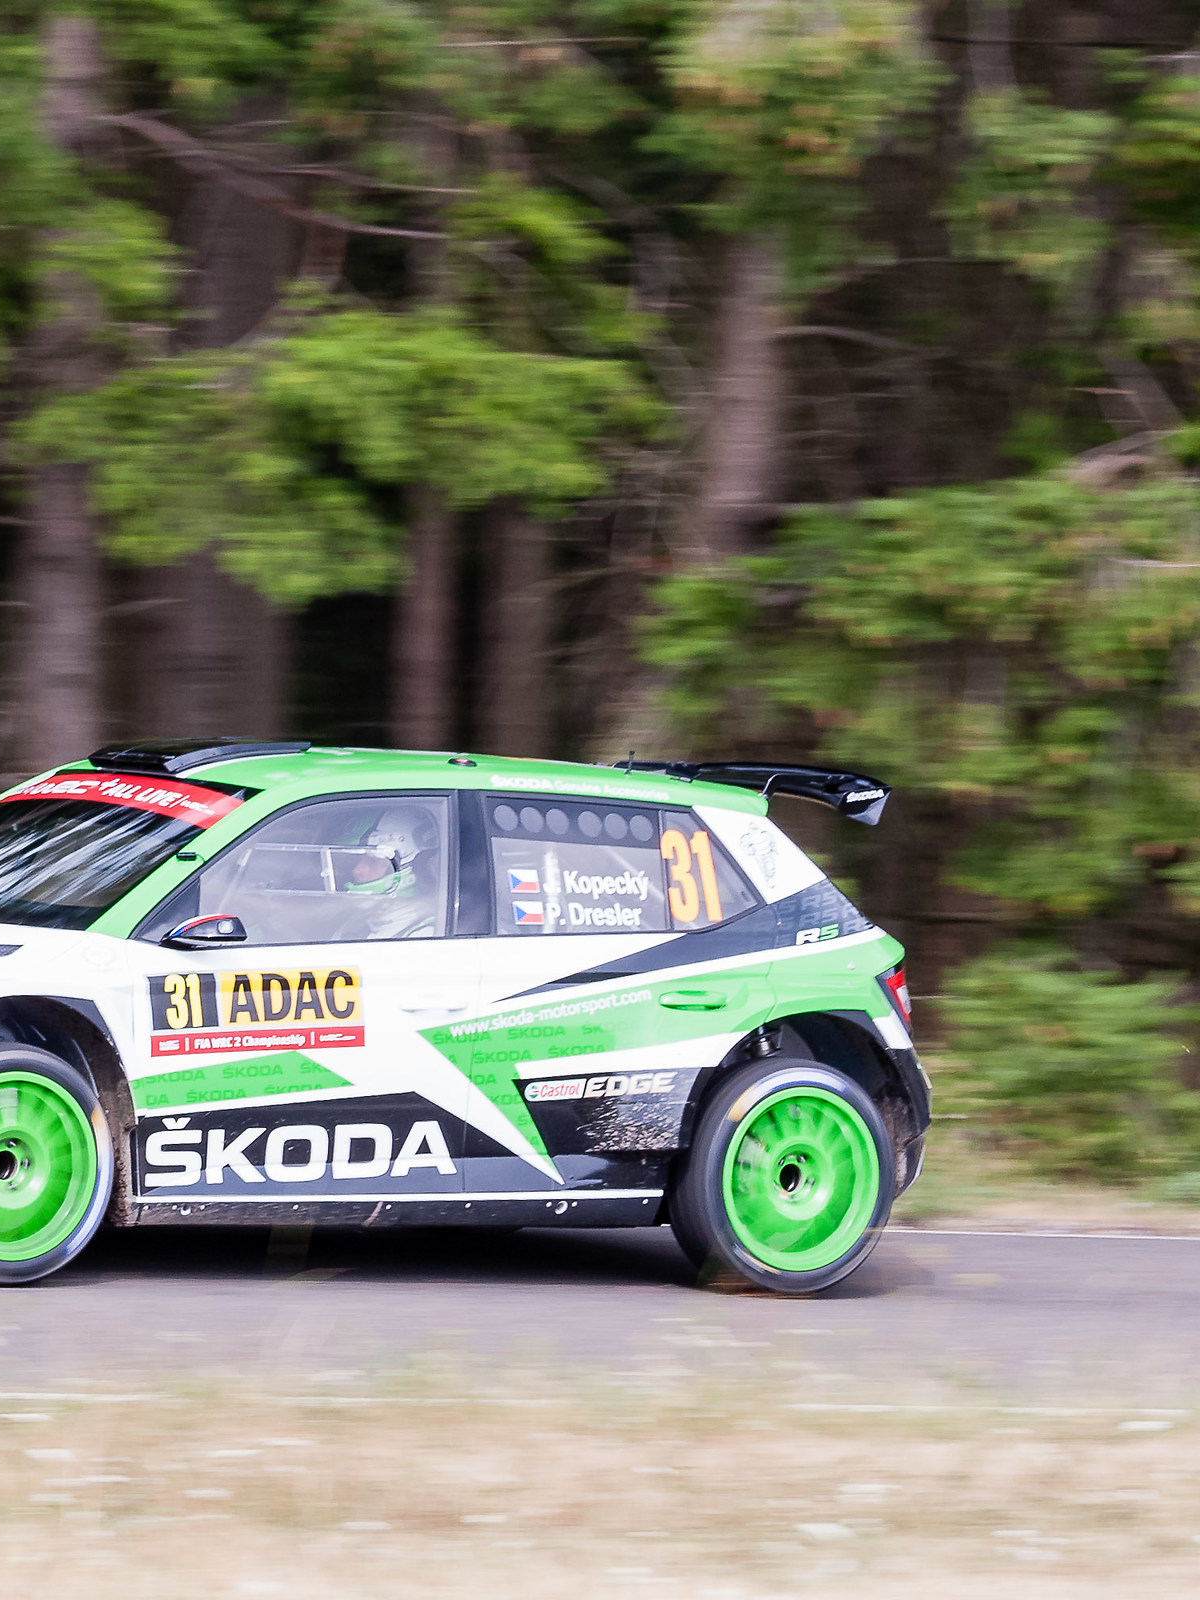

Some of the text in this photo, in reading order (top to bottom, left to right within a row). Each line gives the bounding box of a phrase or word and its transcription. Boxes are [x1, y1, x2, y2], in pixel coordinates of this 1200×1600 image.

[563, 871, 649, 900] Kopecký
[660, 829, 722, 922] 31
[545, 902, 642, 926] P. Dresler
[795, 923, 840, 945] R5
[164, 970, 355, 1029] 31 ADAC
[450, 989, 652, 1037] www.skoda-motorsport.com
[507, 1024, 566, 1039] ŠKODA
[473, 1049, 532, 1064] ŠKODA
[222, 1064, 283, 1079] ŠKODA
[186, 1089, 246, 1104] ŠKODA
[540, 1071, 678, 1098] Castrol EDGE
[145, 1117, 458, 1187] ŠKODA
